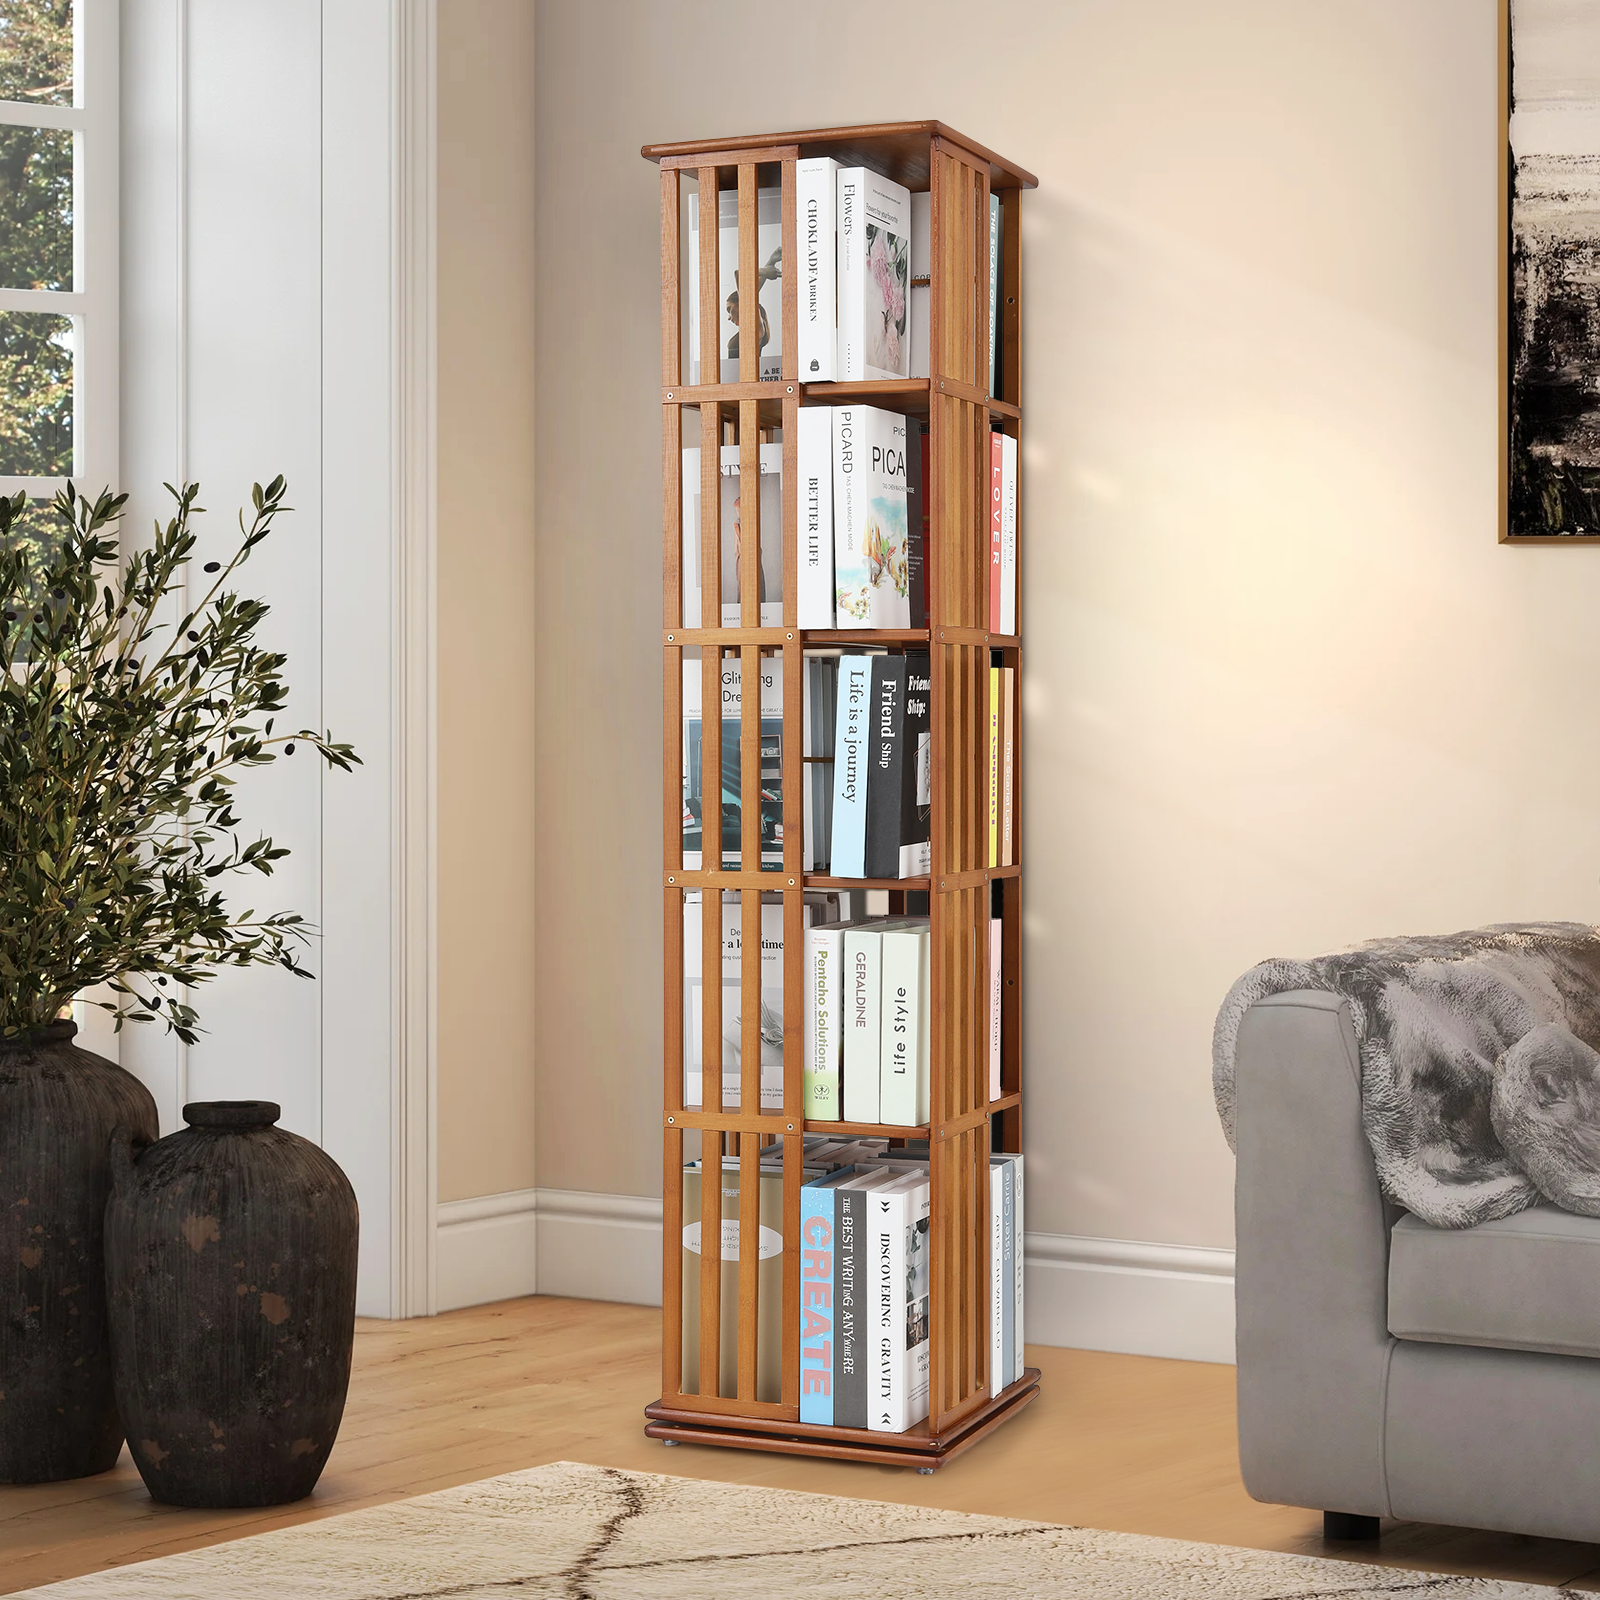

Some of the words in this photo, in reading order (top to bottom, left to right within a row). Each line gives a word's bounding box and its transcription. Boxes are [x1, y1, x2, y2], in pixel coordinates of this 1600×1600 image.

[844, 184, 856, 236] Flowers
[807, 199, 818, 322] CHOKLADFABRIKEN
[990, 288, 994, 306] OF
[841, 412, 852, 474] PICARD
[808, 478, 818, 532] BETTER
[808, 536, 818, 567] LIFE
[848, 670, 864, 704] Life
[881, 680, 897, 738] Friend
[907, 698, 926, 718] Ship:
[848, 708, 863, 720] is
[848, 726, 858, 734] a
[842, 738, 862, 803] journey
[878, 742, 892, 768] Ship
[818, 950, 828, 1006] Pentaho
[856, 952, 866, 1028] GERALDINE
[894, 987, 908, 1032] Style
[818, 1010, 828, 1070] Solutions
[894, 1042, 906, 1074] Life
[842, 1197, 850, 1214] THE
[842, 1216, 854, 1253] BEST
[803, 1216, 832, 1396] CREATE
[880, 1233, 892, 1328] IDSCOVERING
[881, 1338, 892, 1401] GRAVITY
